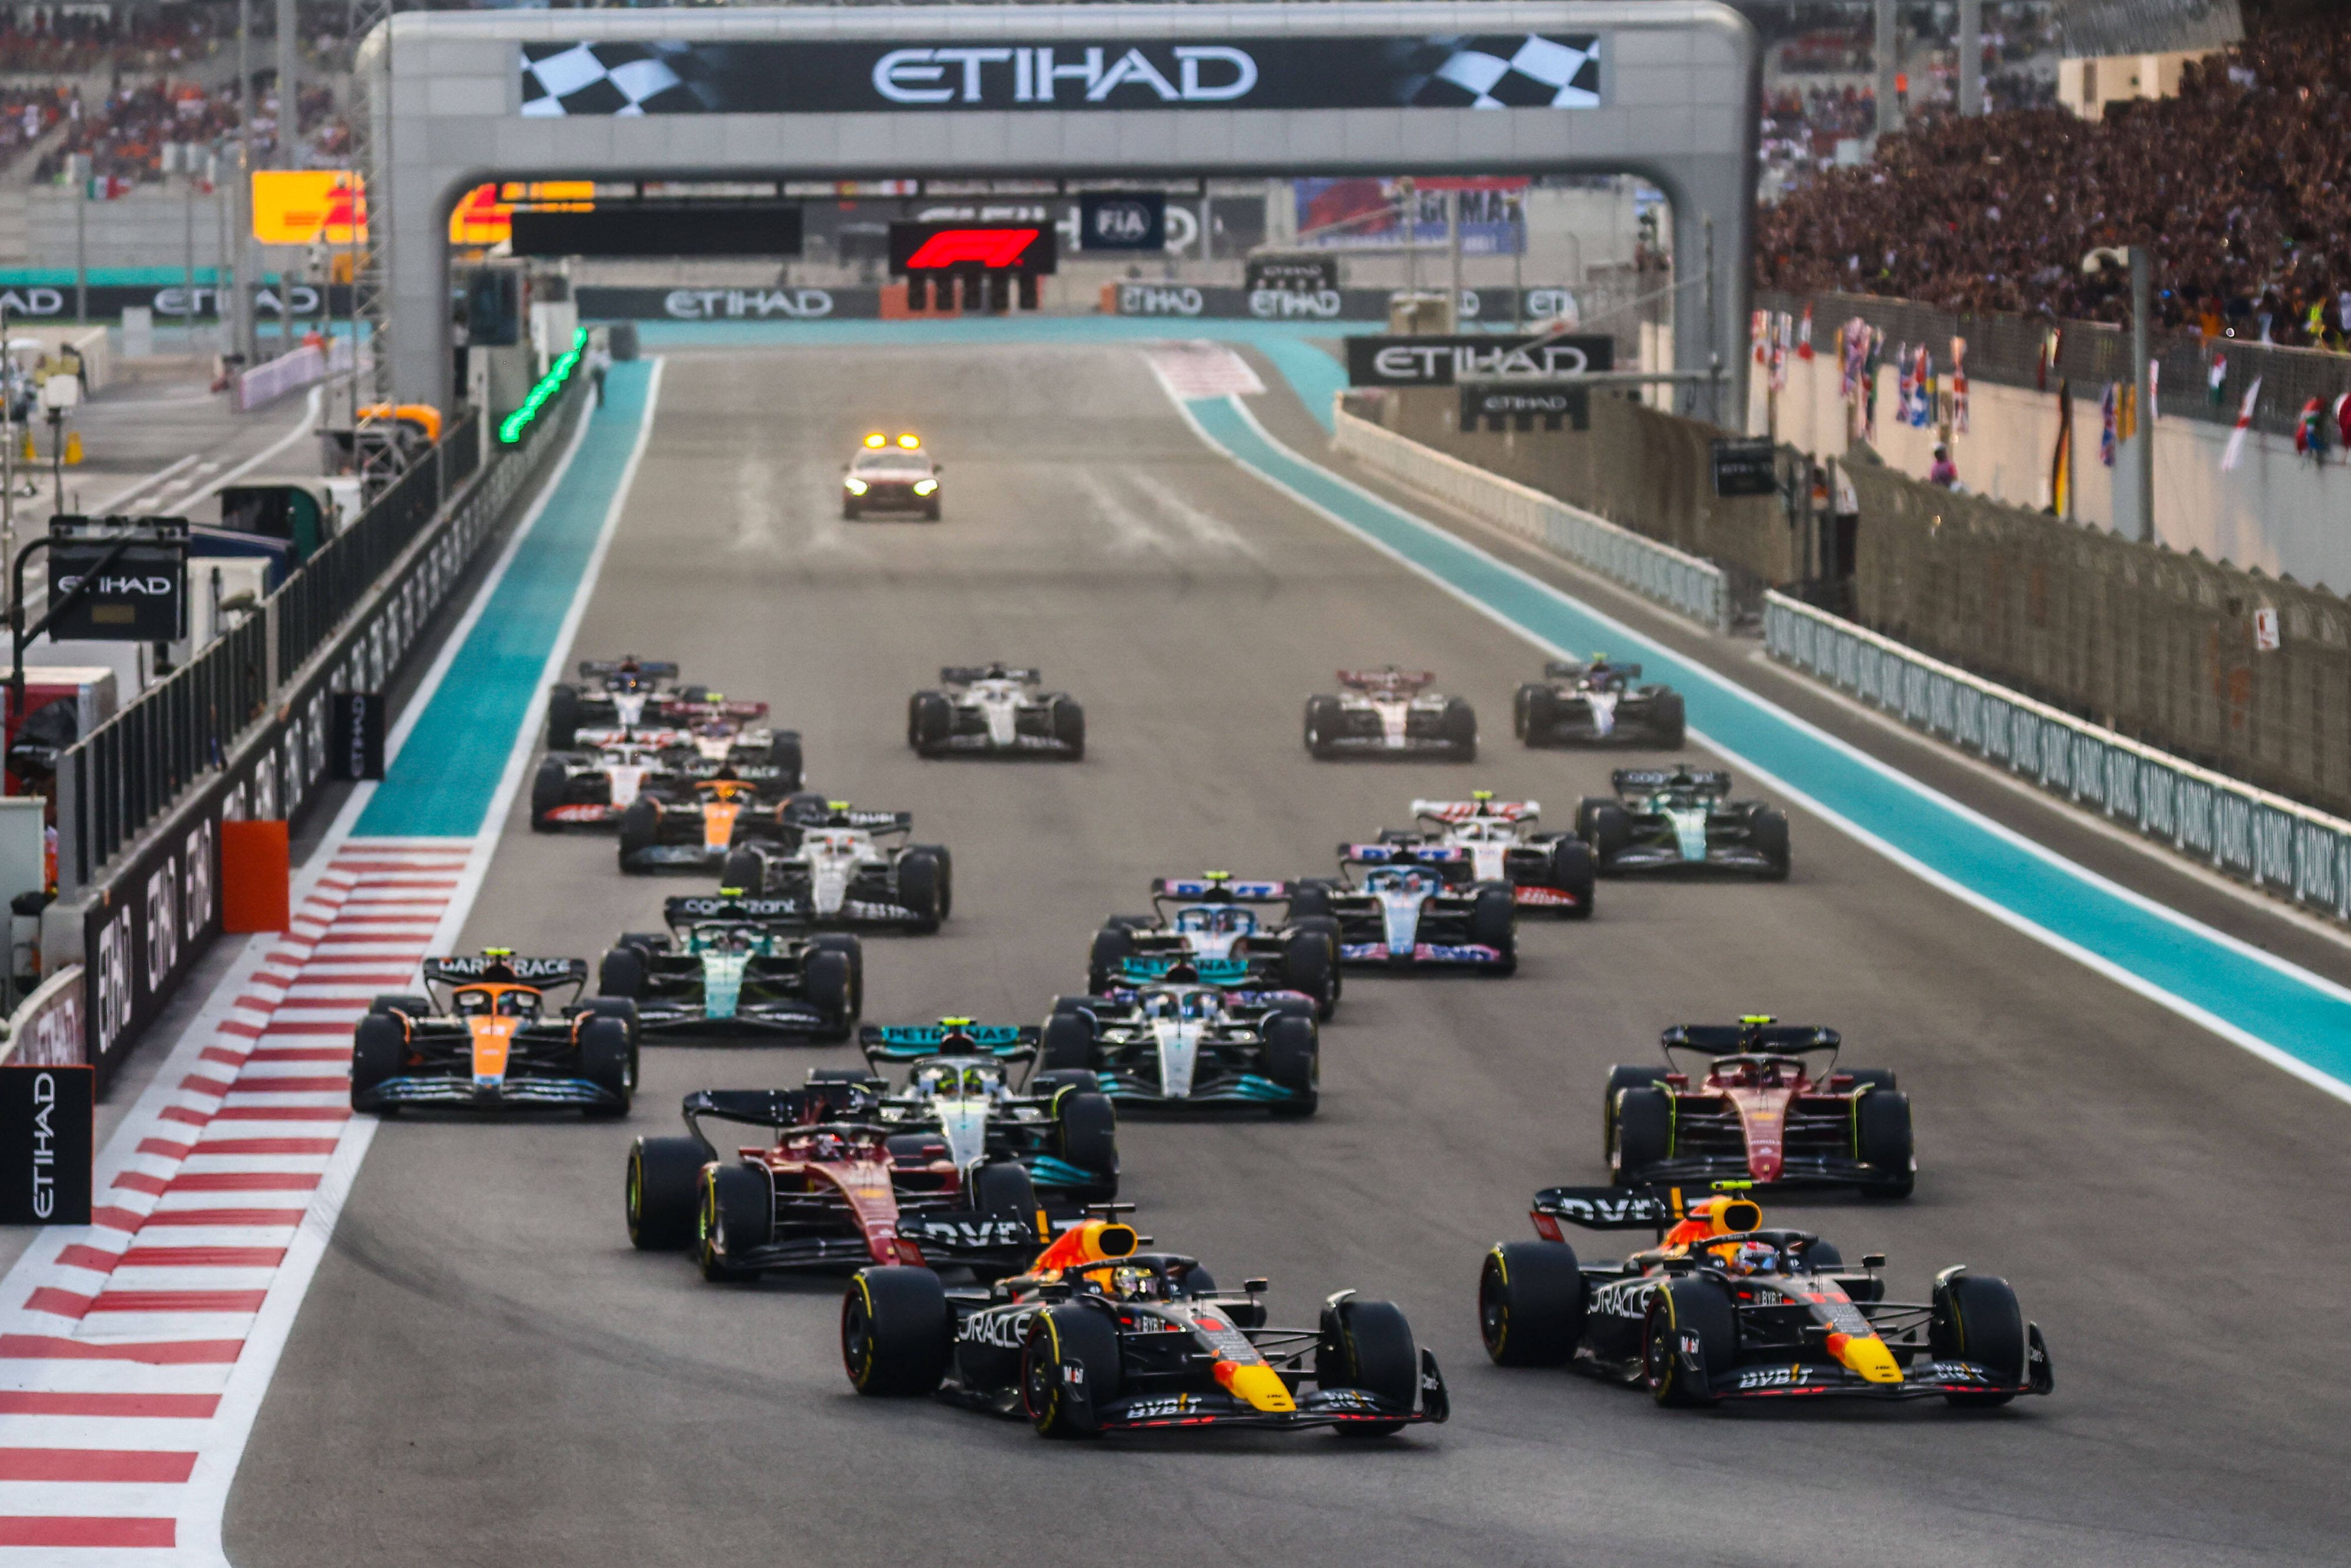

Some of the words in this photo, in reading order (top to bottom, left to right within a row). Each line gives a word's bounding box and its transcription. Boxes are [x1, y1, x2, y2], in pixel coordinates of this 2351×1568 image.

[872, 46, 1258, 103] ETIHAD
[665, 290, 833, 317] ETIHAD
[1374, 346, 1588, 377] ETIHAD
[58, 575, 171, 595] EIHAD
[888, 1028, 1013, 1041] PETRNAS
[33, 1072, 55, 1219] ETIHAD
